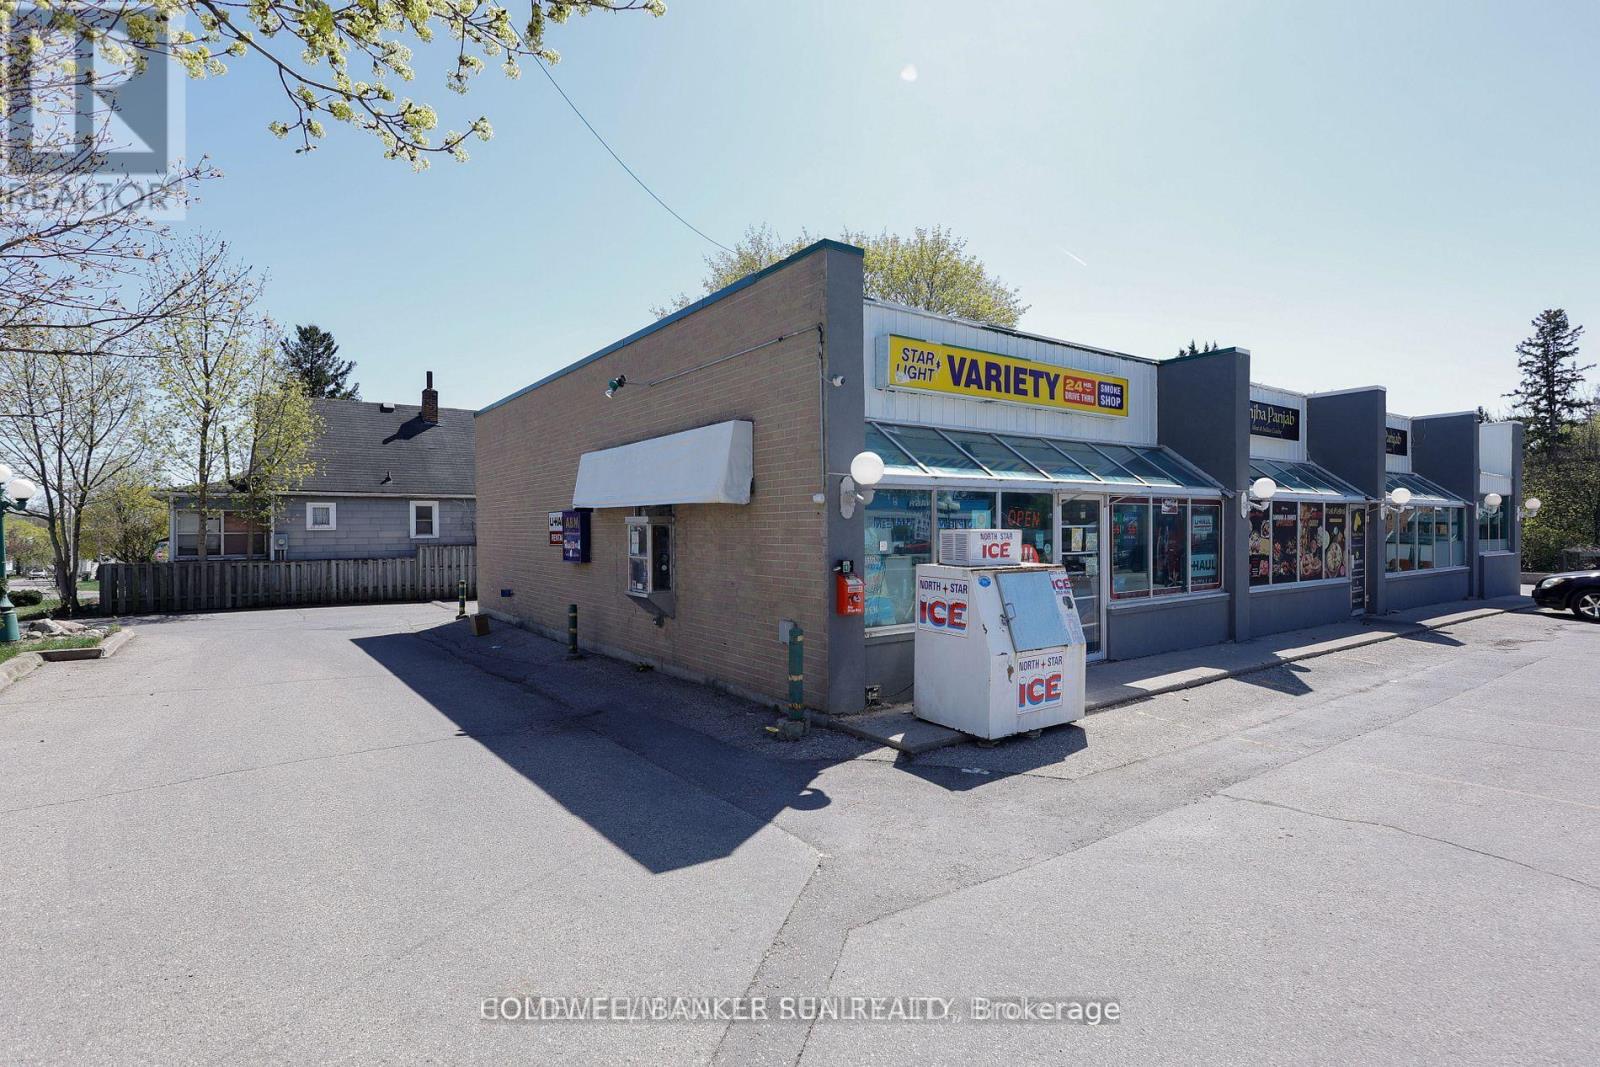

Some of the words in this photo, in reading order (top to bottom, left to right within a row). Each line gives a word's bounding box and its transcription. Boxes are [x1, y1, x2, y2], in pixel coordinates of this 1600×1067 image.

[901, 347, 935, 366] STAR
[947, 354, 1061, 400] VARIETY
[1065, 379, 1083, 393] 24
[1100, 384, 1121, 396] SMOKE
[1064, 391, 1080, 402] DRIVE
[1080, 393, 1095, 404] THRU
[1100, 394, 1121, 407] SHOP
[1007, 508, 1041, 528] OPEN
[979, 532, 998, 541] NORTH
[1000, 532, 1013, 541] STAR
[982, 542, 1010, 559] ICE
[919, 579, 941, 591] NORTH
[950, 583, 968, 595] STAR
[1051, 577, 1073, 590] ICE
[919, 597, 967, 631] ICE
[1018, 661, 1040, 672] NORTH
[1047, 656, 1063, 667] STAR
[1018, 673, 1062, 708] ICE
